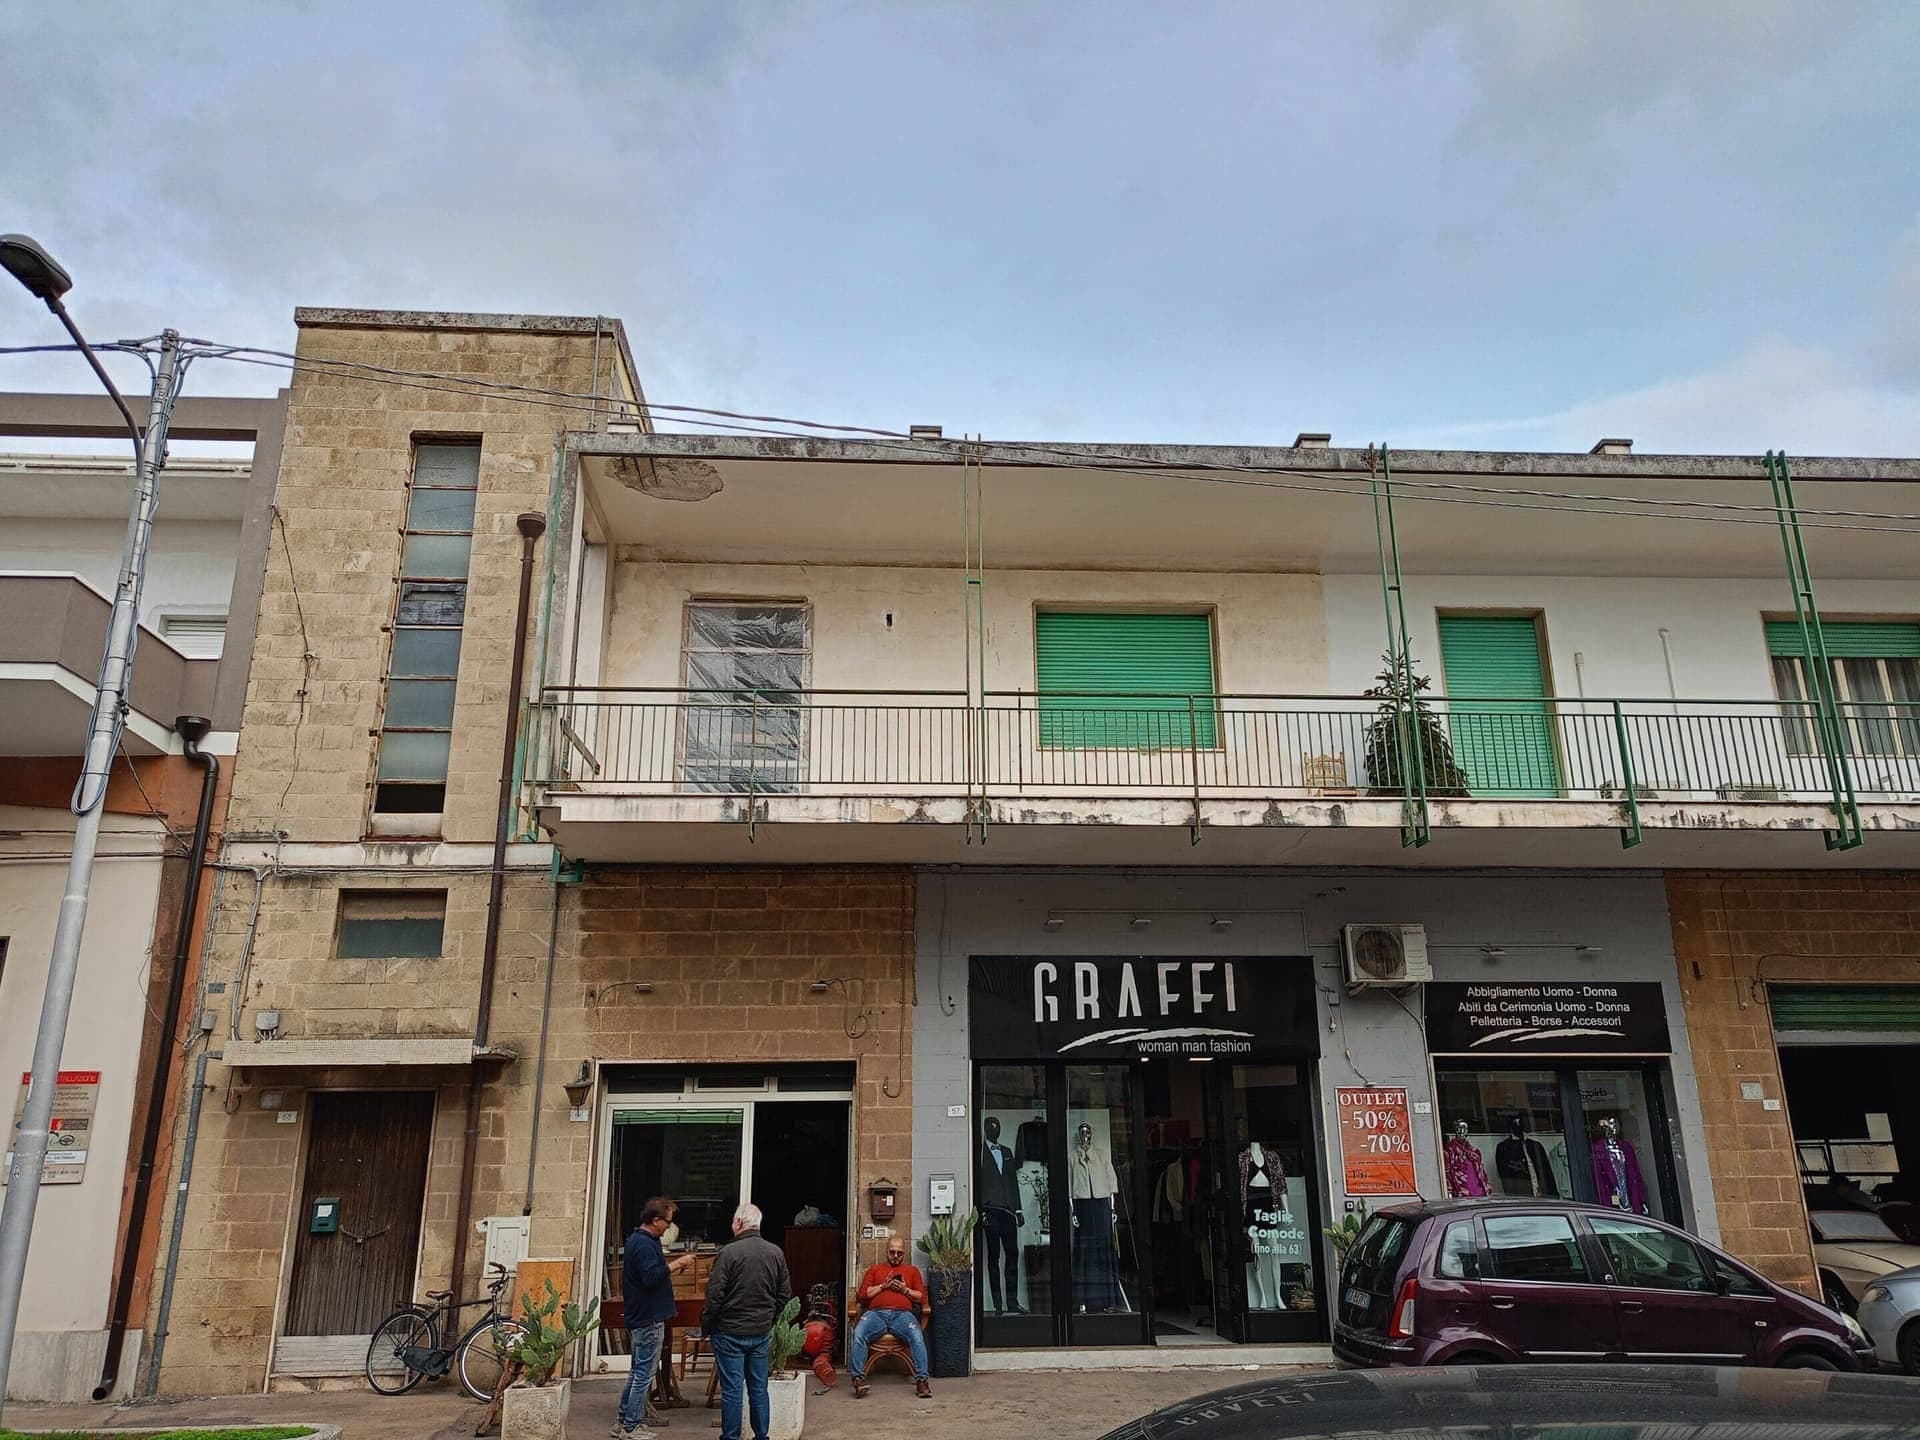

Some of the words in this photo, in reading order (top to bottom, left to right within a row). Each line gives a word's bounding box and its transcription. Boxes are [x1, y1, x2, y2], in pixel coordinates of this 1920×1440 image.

[1033, 962, 1237, 1022] GRAFFI
[1467, 986, 1541, 998] Abbigliamento
[1543, 986, 1574, 997] Uomo
[1583, 986, 1617, 997] Donna
[1458, 1001, 1482, 1012] Abiti
[1484, 1001, 1497, 1012] da
[1500, 1001, 1553, 1012] Cerimonia
[1555, 1001, 1587, 1012] Uomo
[1596, 1001, 1630, 1012] Donna
[1470, 1015, 1522, 1026] Pelletteria
[1531, 1015, 1563, 1026] Borse
[1571, 1015, 1622, 1026] Accessori
[1137, 1042, 1179, 1052] woman
[1182, 1042, 1207, 1052] man
[1210, 1039, 1251, 1052] fashion
[1340, 1093, 1405, 1105] OUTLET
[1353, 1110, 1397, 1129] 50%
[1360, 1134, 1410, 1153] -70%
[1253, 1209, 1294, 1224] Taglie
[1248, 1225, 1305, 1240] Comode
